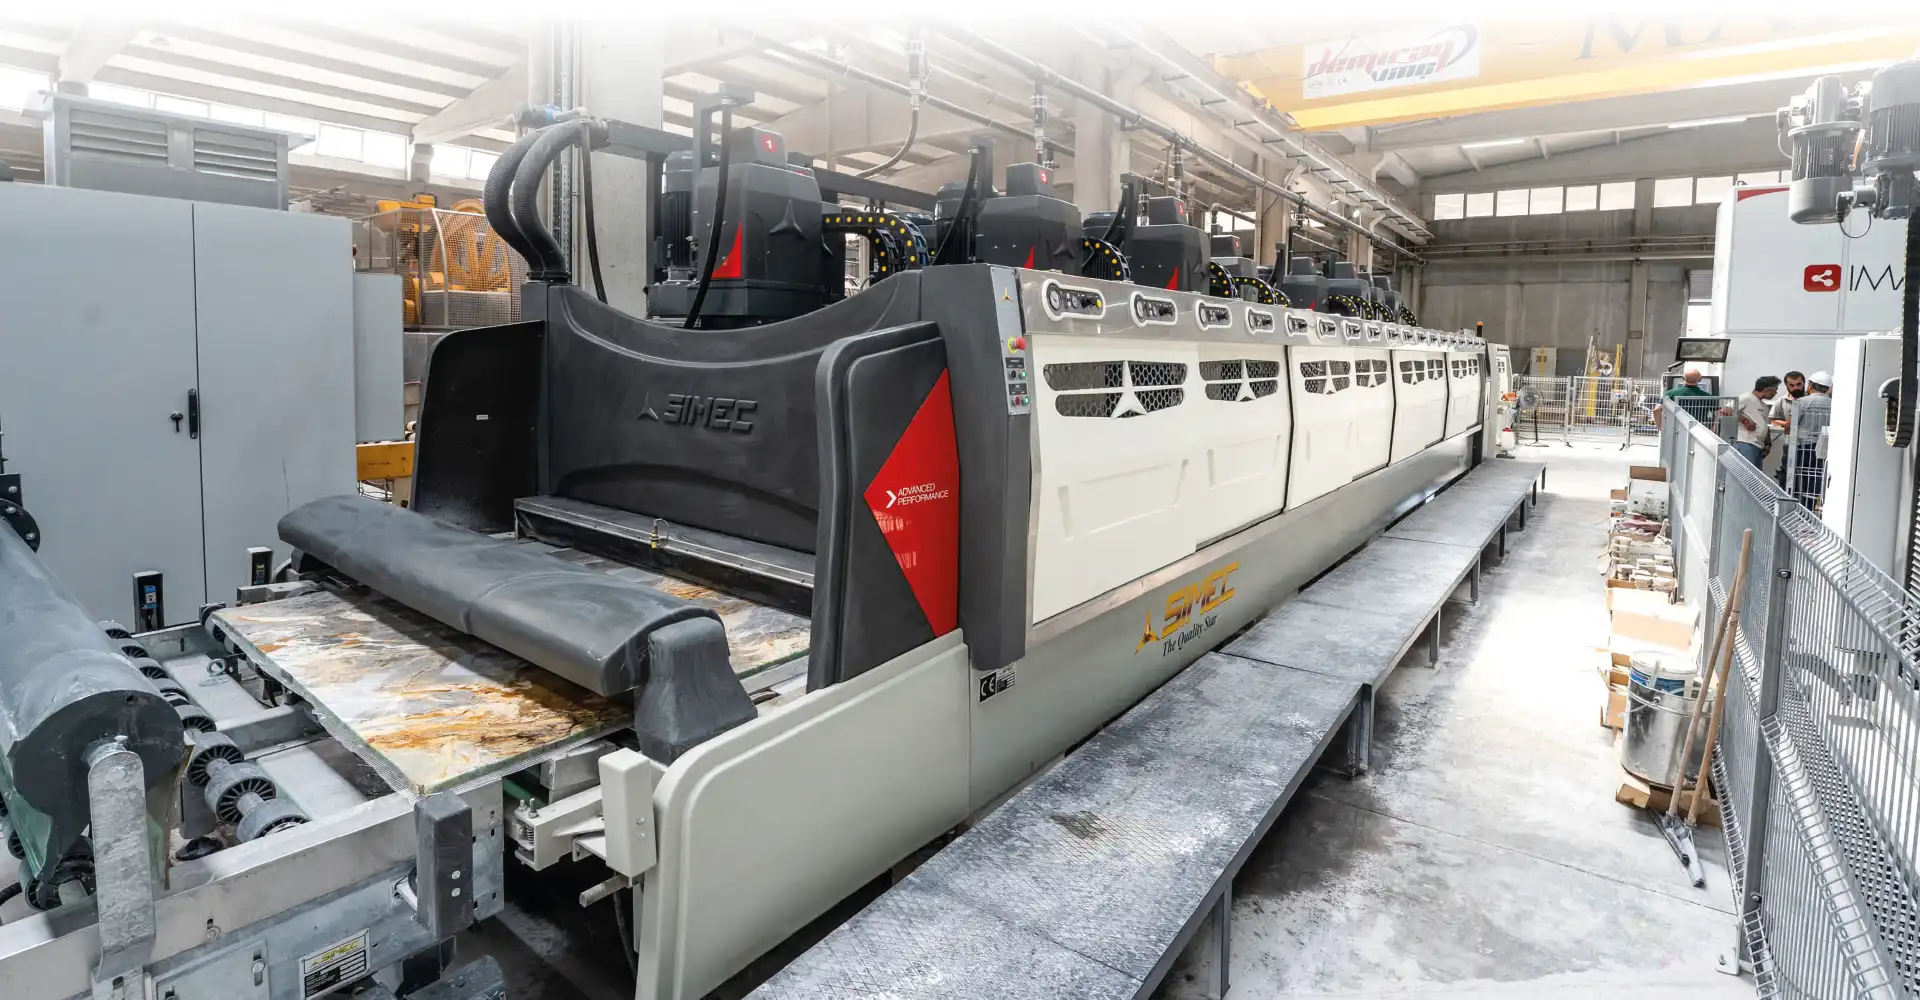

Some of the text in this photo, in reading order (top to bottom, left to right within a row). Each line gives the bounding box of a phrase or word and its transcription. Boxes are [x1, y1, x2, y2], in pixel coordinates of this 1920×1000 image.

[765, 140, 772, 149] 1
[663, 393, 758, 433] SIMEC
[897, 483, 936, 497] ADVANCED
[897, 489, 949, 506] PERFORMANCE
[1161, 560, 1239, 639] SIMEC
[1162, 615, 1218, 657] The Quality Star
[981, 676, 995, 696] CE
